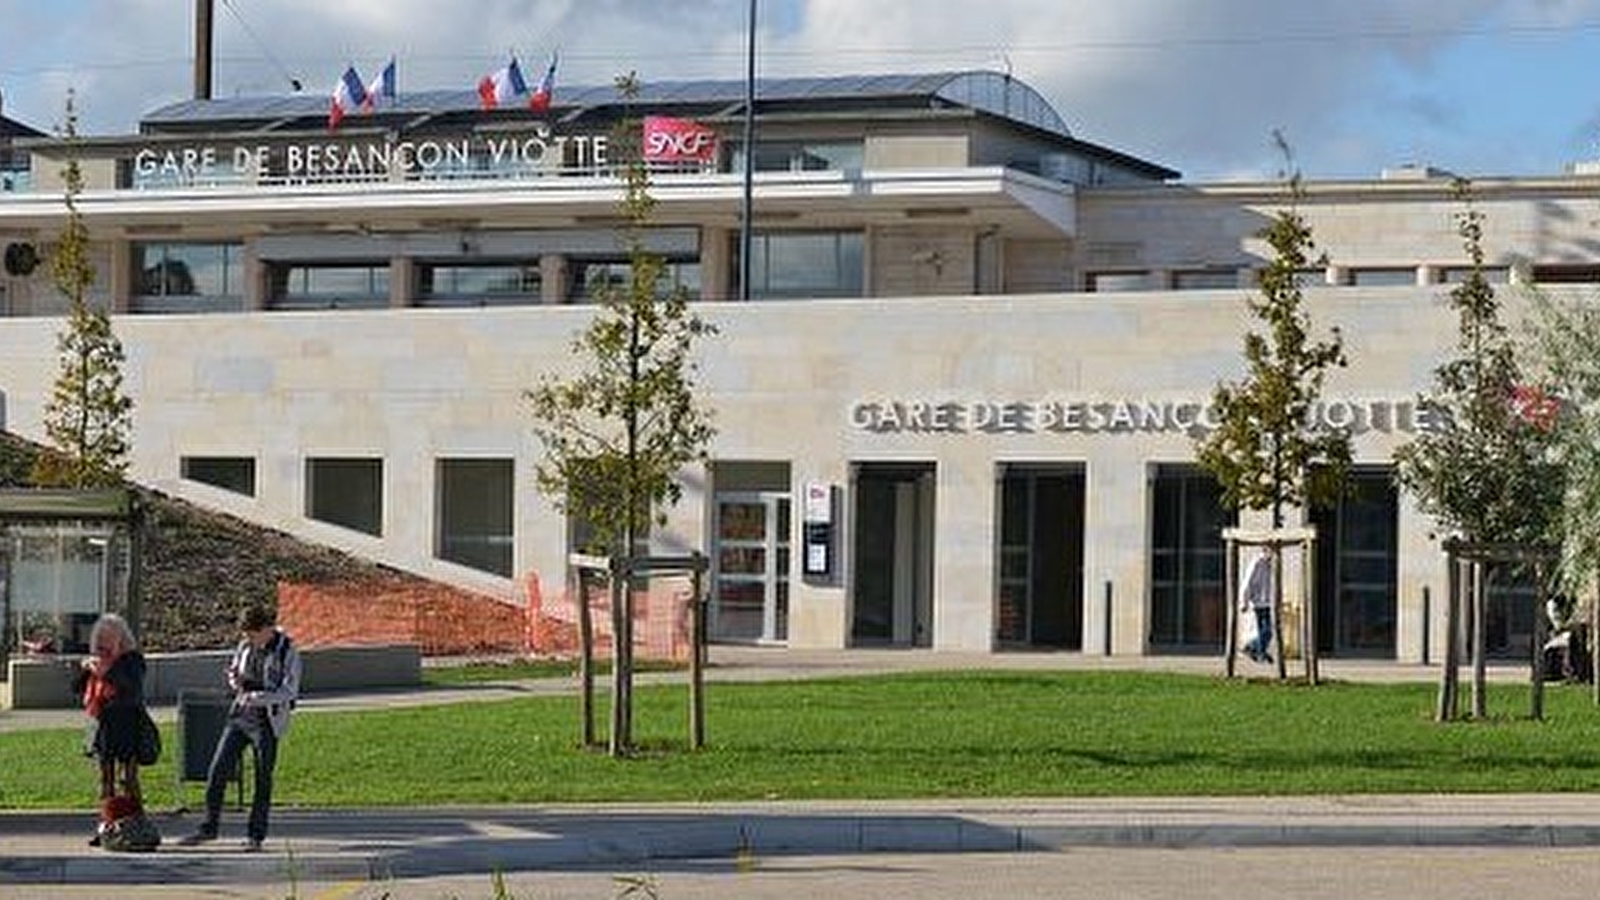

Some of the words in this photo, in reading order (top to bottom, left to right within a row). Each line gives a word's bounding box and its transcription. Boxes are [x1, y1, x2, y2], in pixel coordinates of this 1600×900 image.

[650, 130, 715, 156] SNCF
[135, 148, 216, 175] GARE
[233, 146, 270, 172] DE
[849, 399, 950, 429] GARE
[966, 399, 1018, 429] DE
